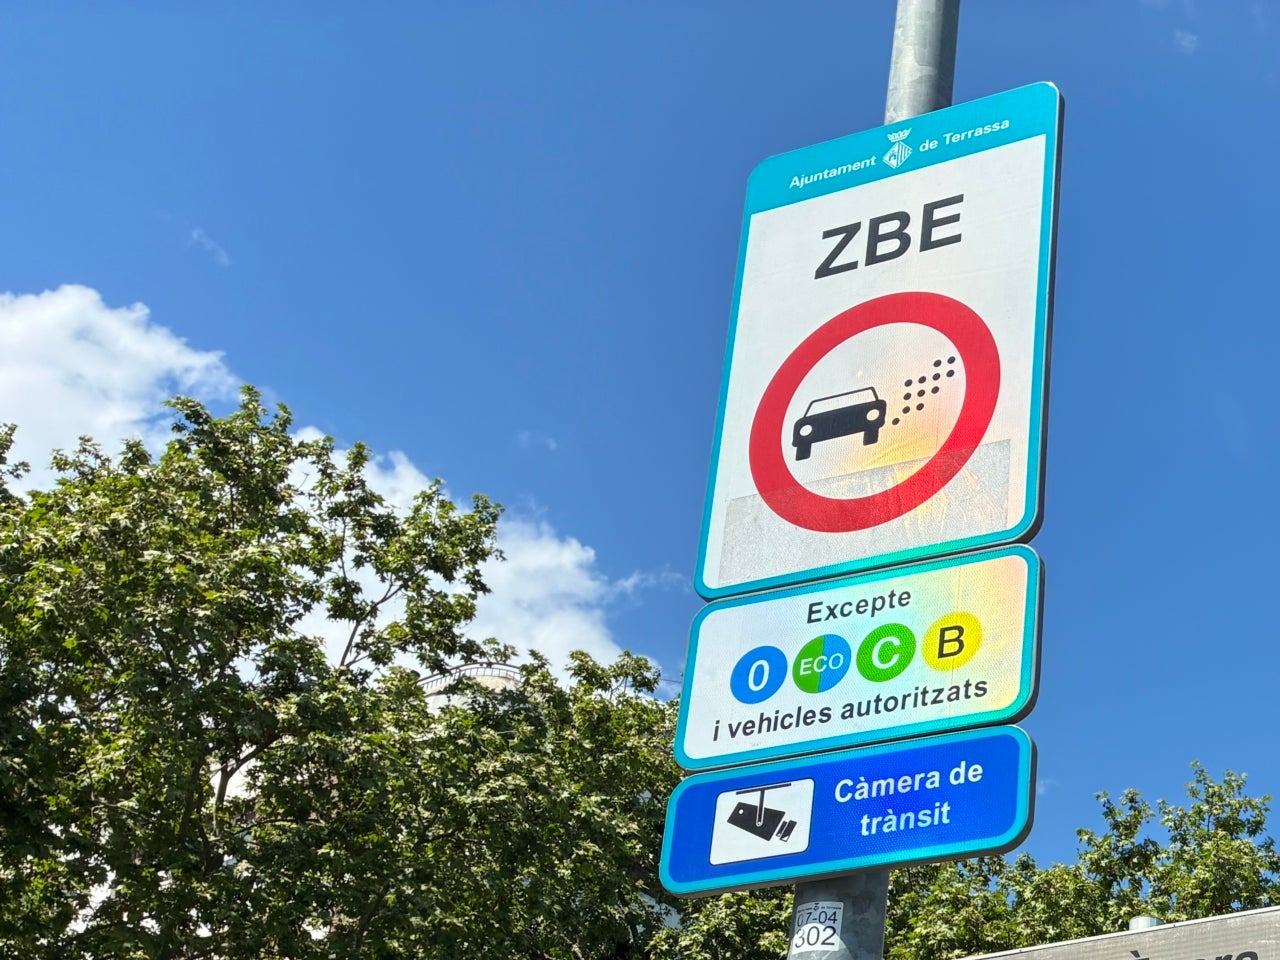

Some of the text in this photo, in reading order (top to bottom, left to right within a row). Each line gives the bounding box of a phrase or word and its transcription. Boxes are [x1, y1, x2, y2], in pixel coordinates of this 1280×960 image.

[790, 120, 1009, 188] Ajuntament de Terrassa
[815, 194, 964, 279] ZBE
[807, 590, 911, 624] Excepte
[800, 654, 843, 675] ECO
[872, 636, 900, 669] C
[938, 626, 964, 658] B
[714, 679, 987, 741] i vehicles autoritzats
[835, 761, 982, 802] Càmera de
[861, 802, 950, 836] trànsit
[795, 926, 836, 948] 302
[797, 910, 838, 926] 07-04
